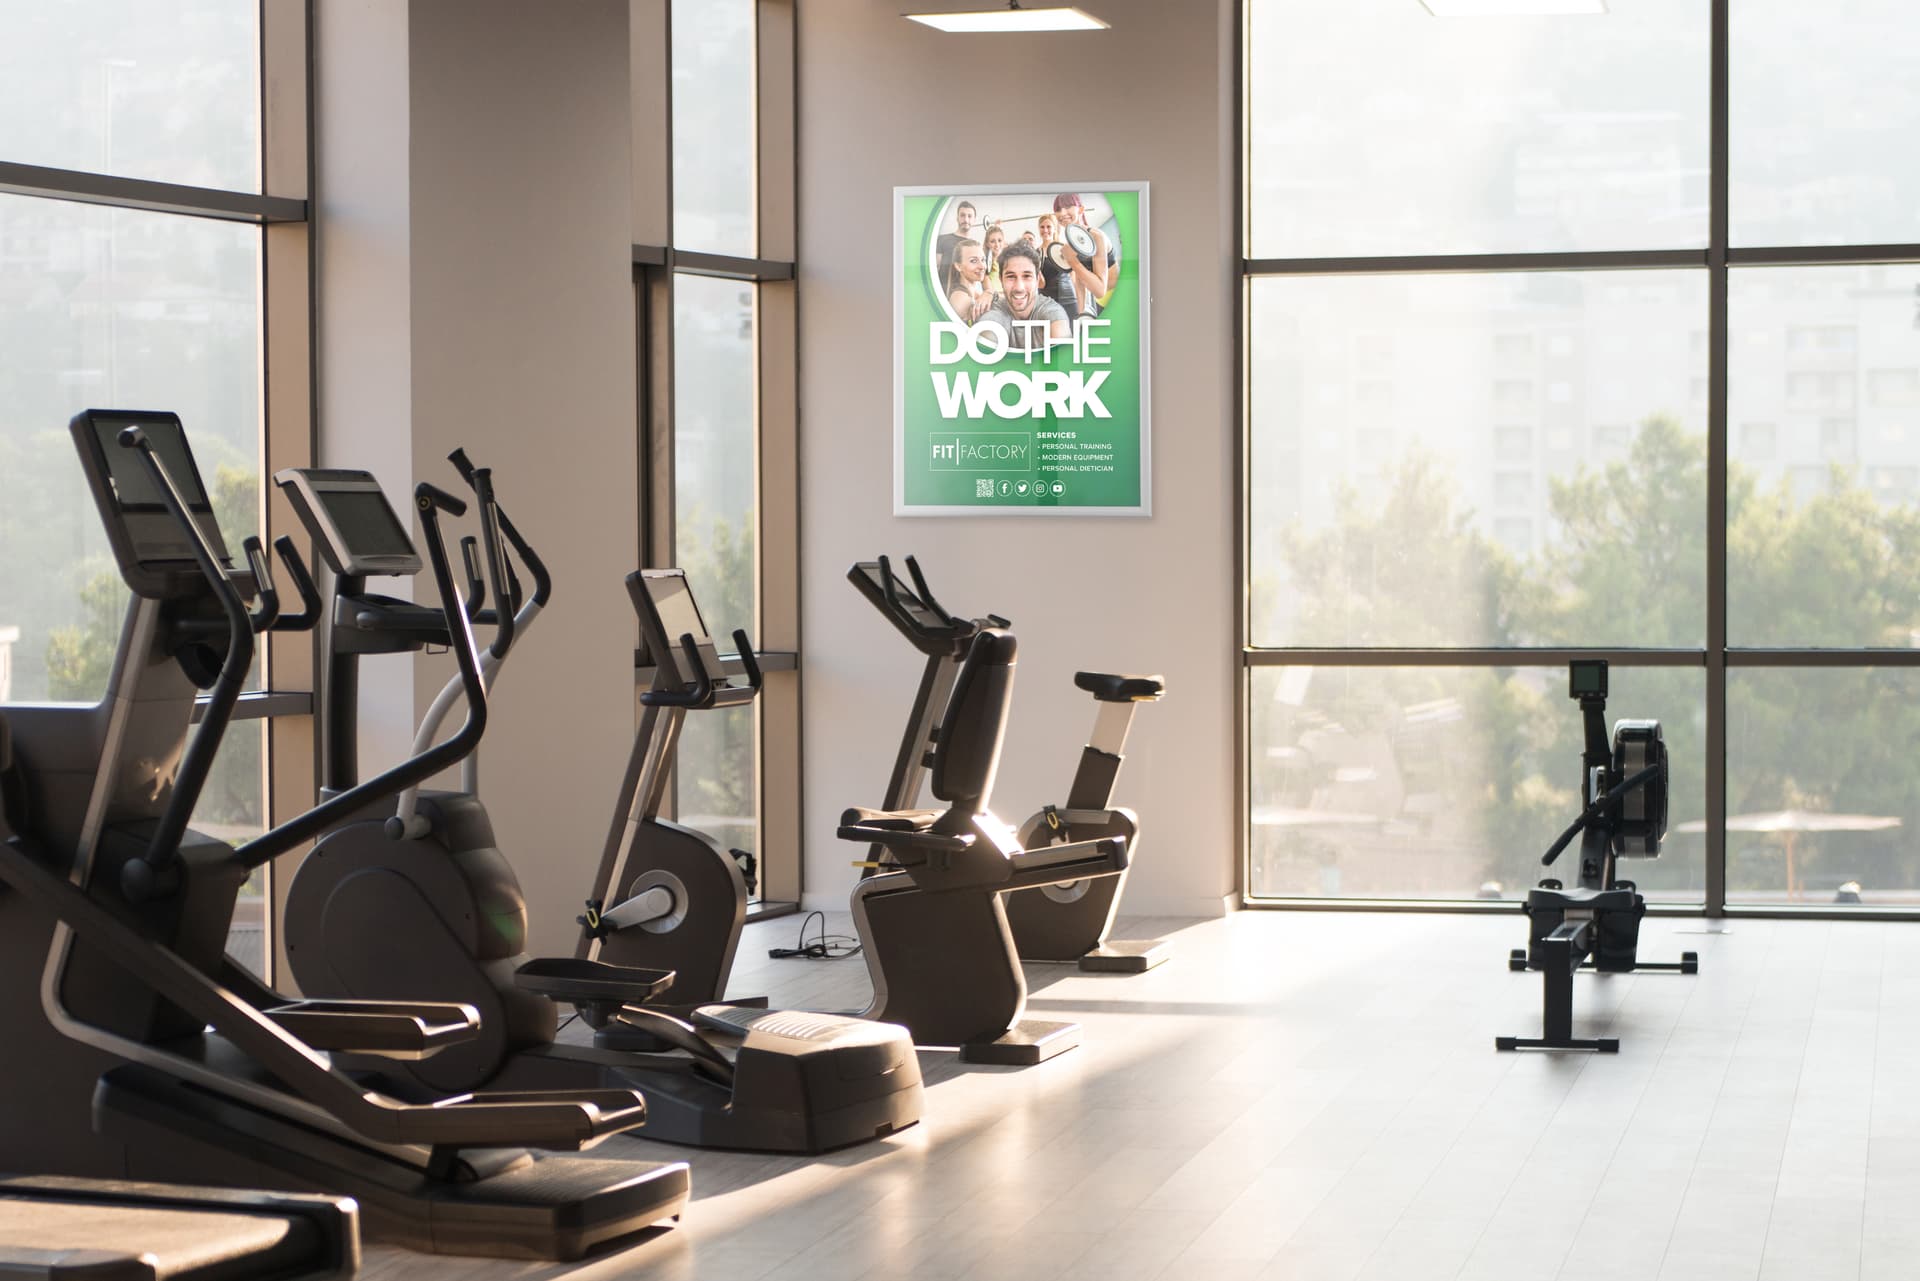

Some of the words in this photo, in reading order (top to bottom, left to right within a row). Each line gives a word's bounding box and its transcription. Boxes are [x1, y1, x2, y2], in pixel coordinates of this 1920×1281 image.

[930, 320, 1010, 364] DO
[1012, 320, 1111, 364] THE
[930, 370, 1112, 419] WORK
[932, 445, 955, 459] FIT
[960, 445, 1028, 459] FACTORY
